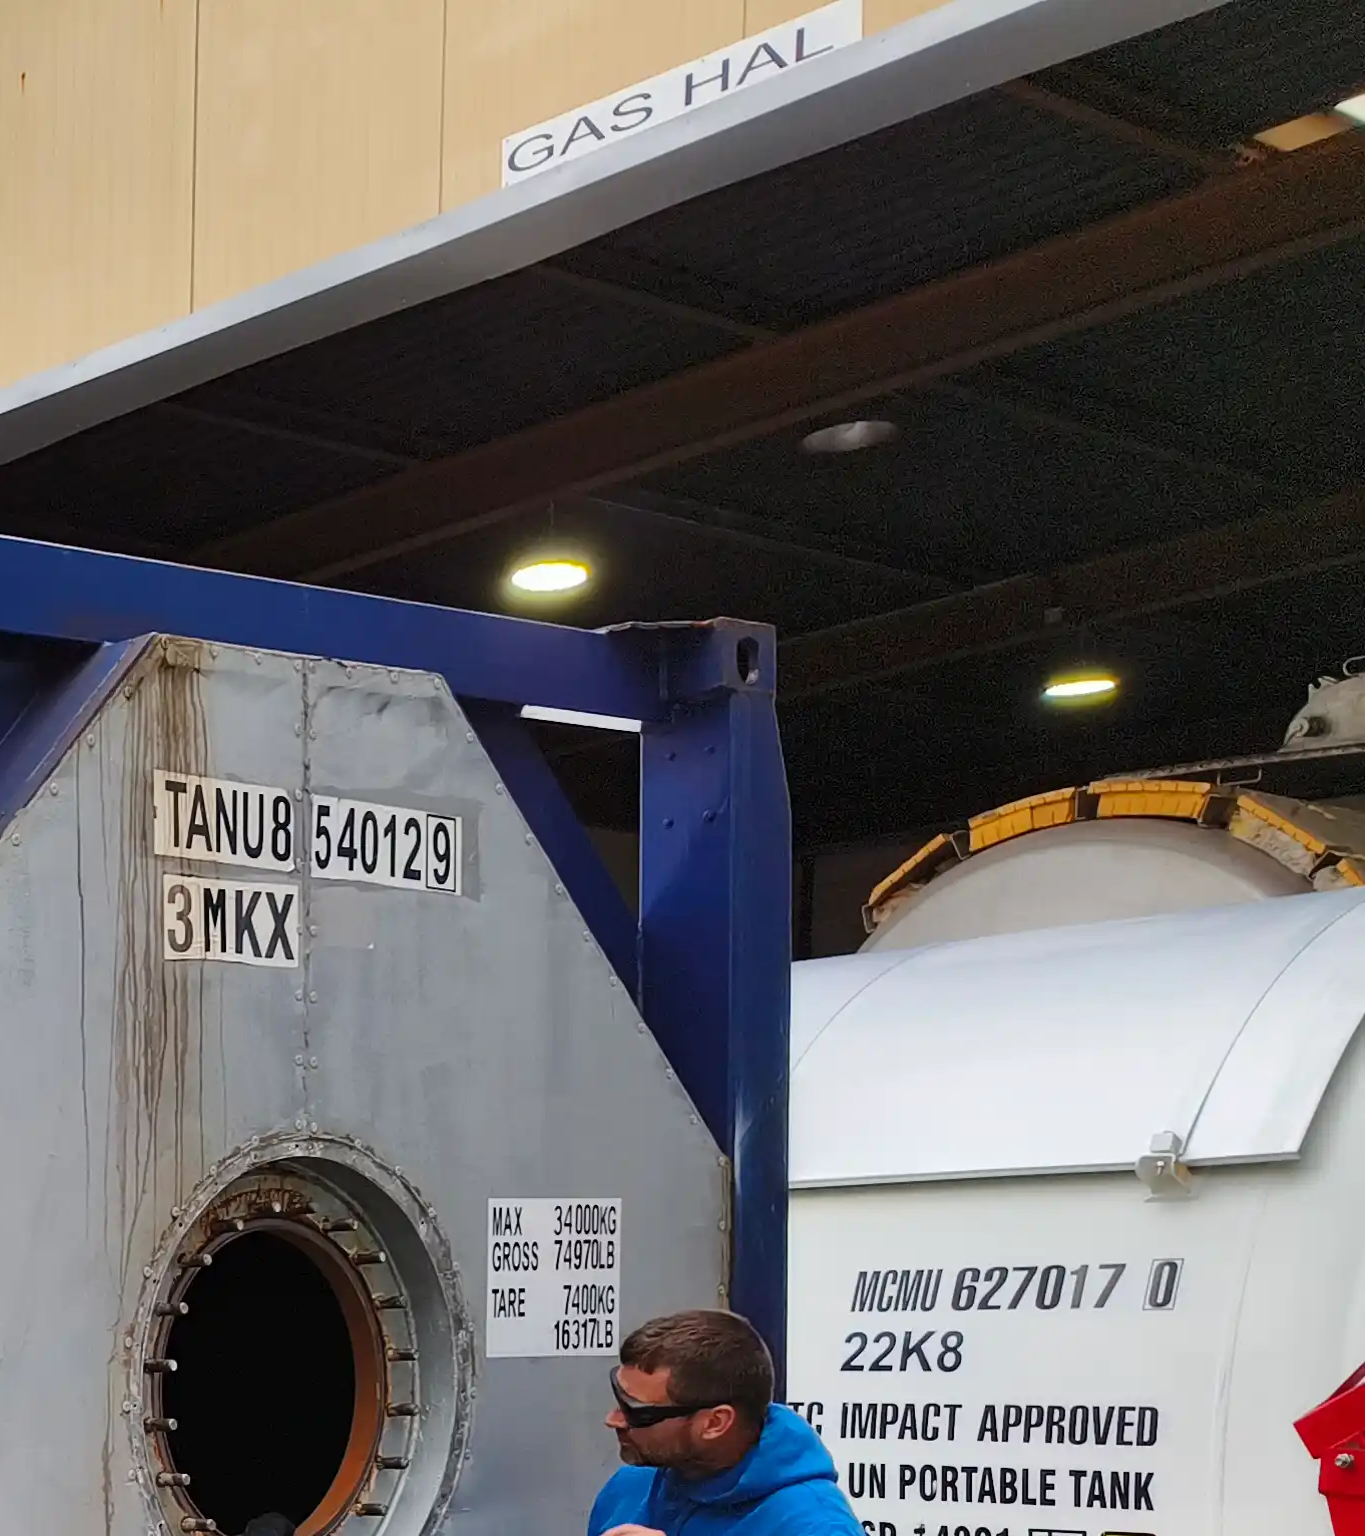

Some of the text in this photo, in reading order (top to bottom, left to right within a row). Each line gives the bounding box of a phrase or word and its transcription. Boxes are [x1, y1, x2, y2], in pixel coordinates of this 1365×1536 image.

[507, 27, 834, 172] GAS HAL
[165, 779, 292, 862] TANU8
[167, 884, 295, 960] 3MKX
[492, 1207, 523, 1236] MAX
[491, 1239, 615, 1272] GROSS 74970LB
[491, 1284, 615, 1318] TARE 7400KG
[851, 1261, 1179, 1312] MCMU 627017 0
[554, 1318, 614, 1350] 16317LB
[840, 1330, 964, 1373] 22K8
[840, 1403, 963, 1442] IMPACT
[977, 1405, 1159, 1447] APPROVED
[848, 1462, 1155, 1512] UN PORTABLE TANK
